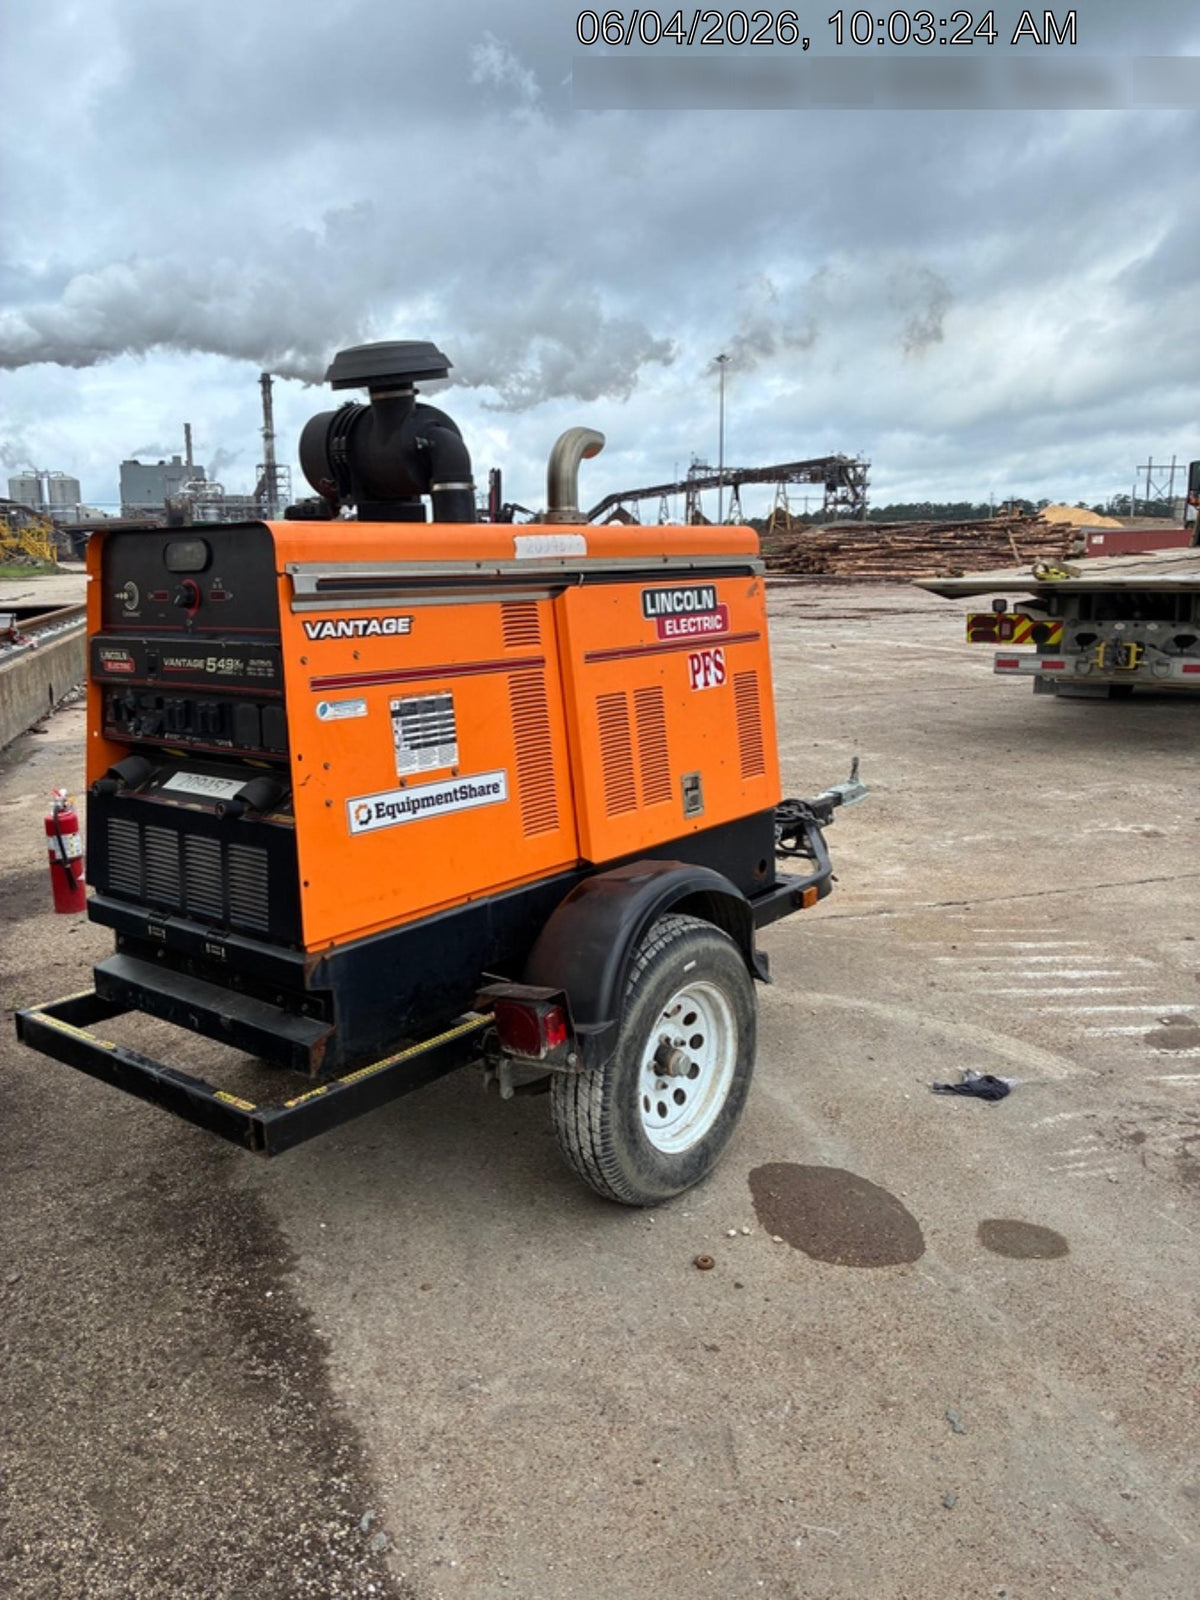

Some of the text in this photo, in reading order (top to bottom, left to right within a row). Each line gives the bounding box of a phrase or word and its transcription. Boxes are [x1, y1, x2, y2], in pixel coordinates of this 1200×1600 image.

[645, 588, 714, 615] LINCOLN
[303, 617, 412, 641] VANTAGE
[664, 615, 723, 636] ELECTRIC
[163, 657, 205, 669] VANTAGE
[689, 648, 726, 690] PFS
[374, 781, 501, 820] EquipmentShare
